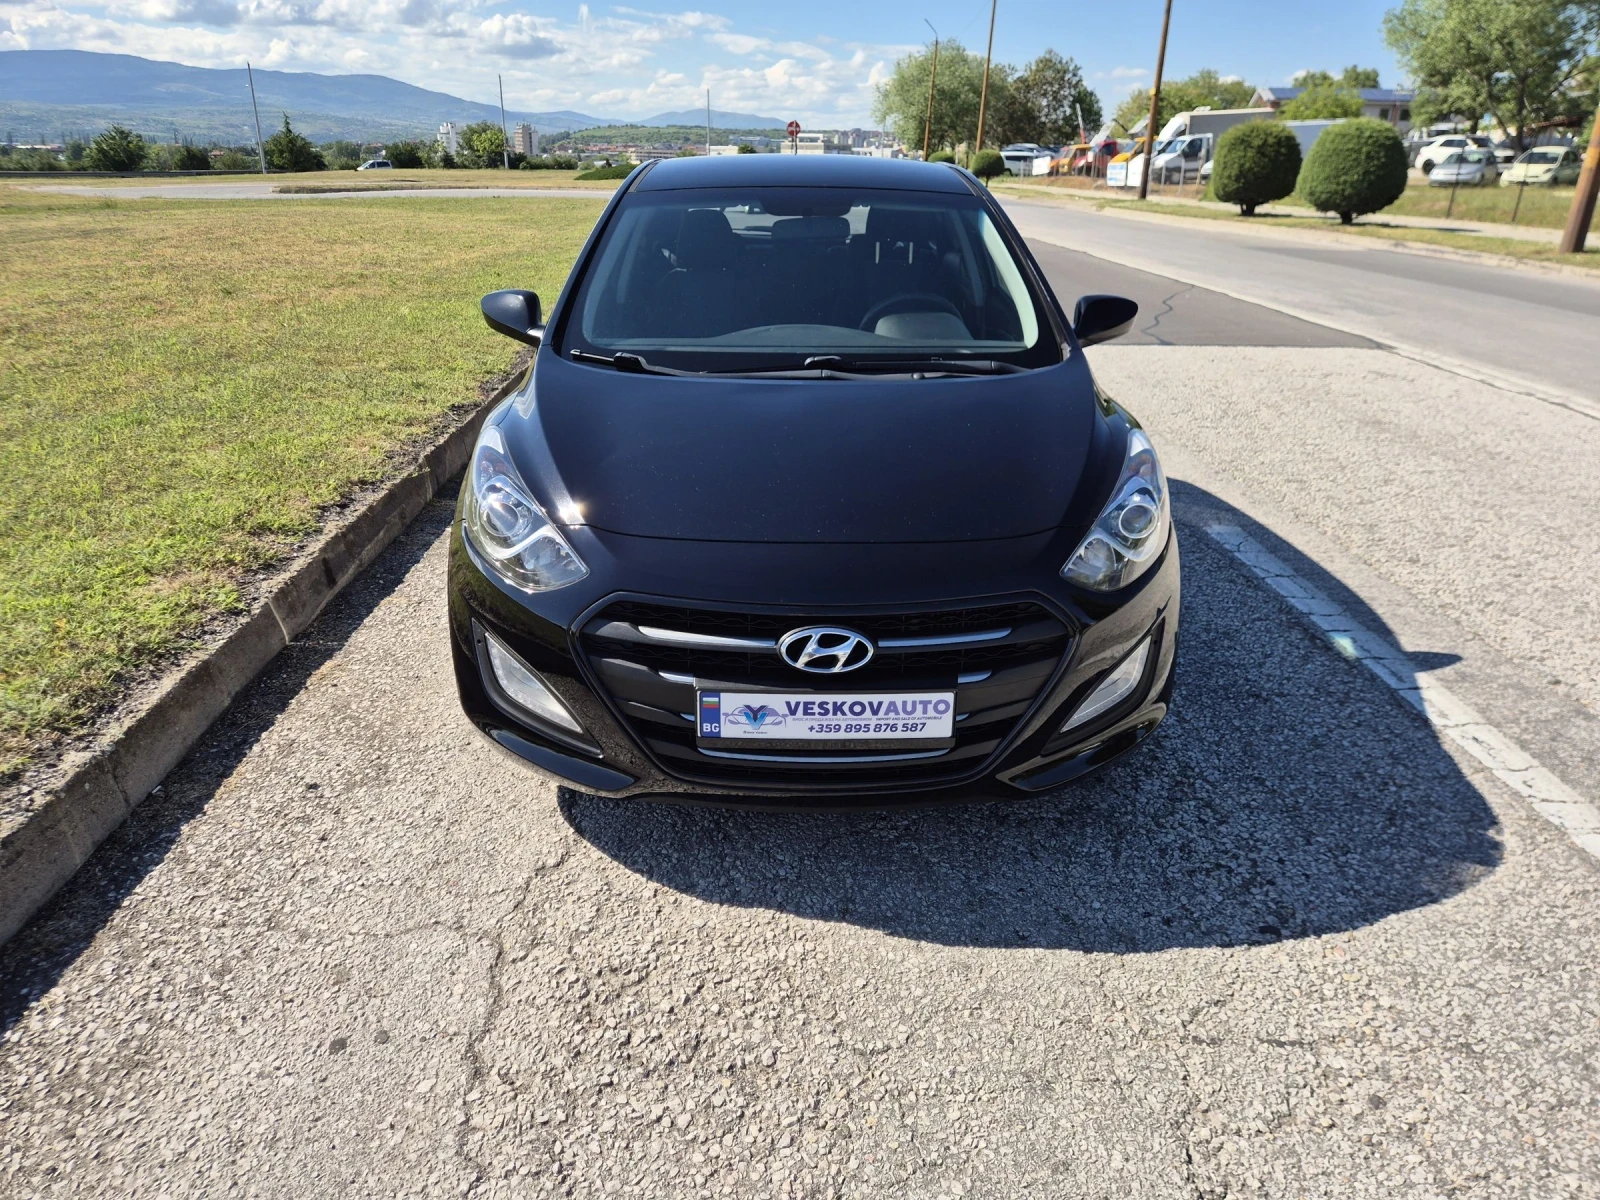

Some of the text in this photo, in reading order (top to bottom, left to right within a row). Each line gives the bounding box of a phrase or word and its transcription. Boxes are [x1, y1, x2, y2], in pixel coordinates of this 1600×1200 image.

[785, 699, 951, 716] VESKOVAUTO
[703, 723, 720, 732] BG
[808, 722, 926, 733] +359 895 876 587
